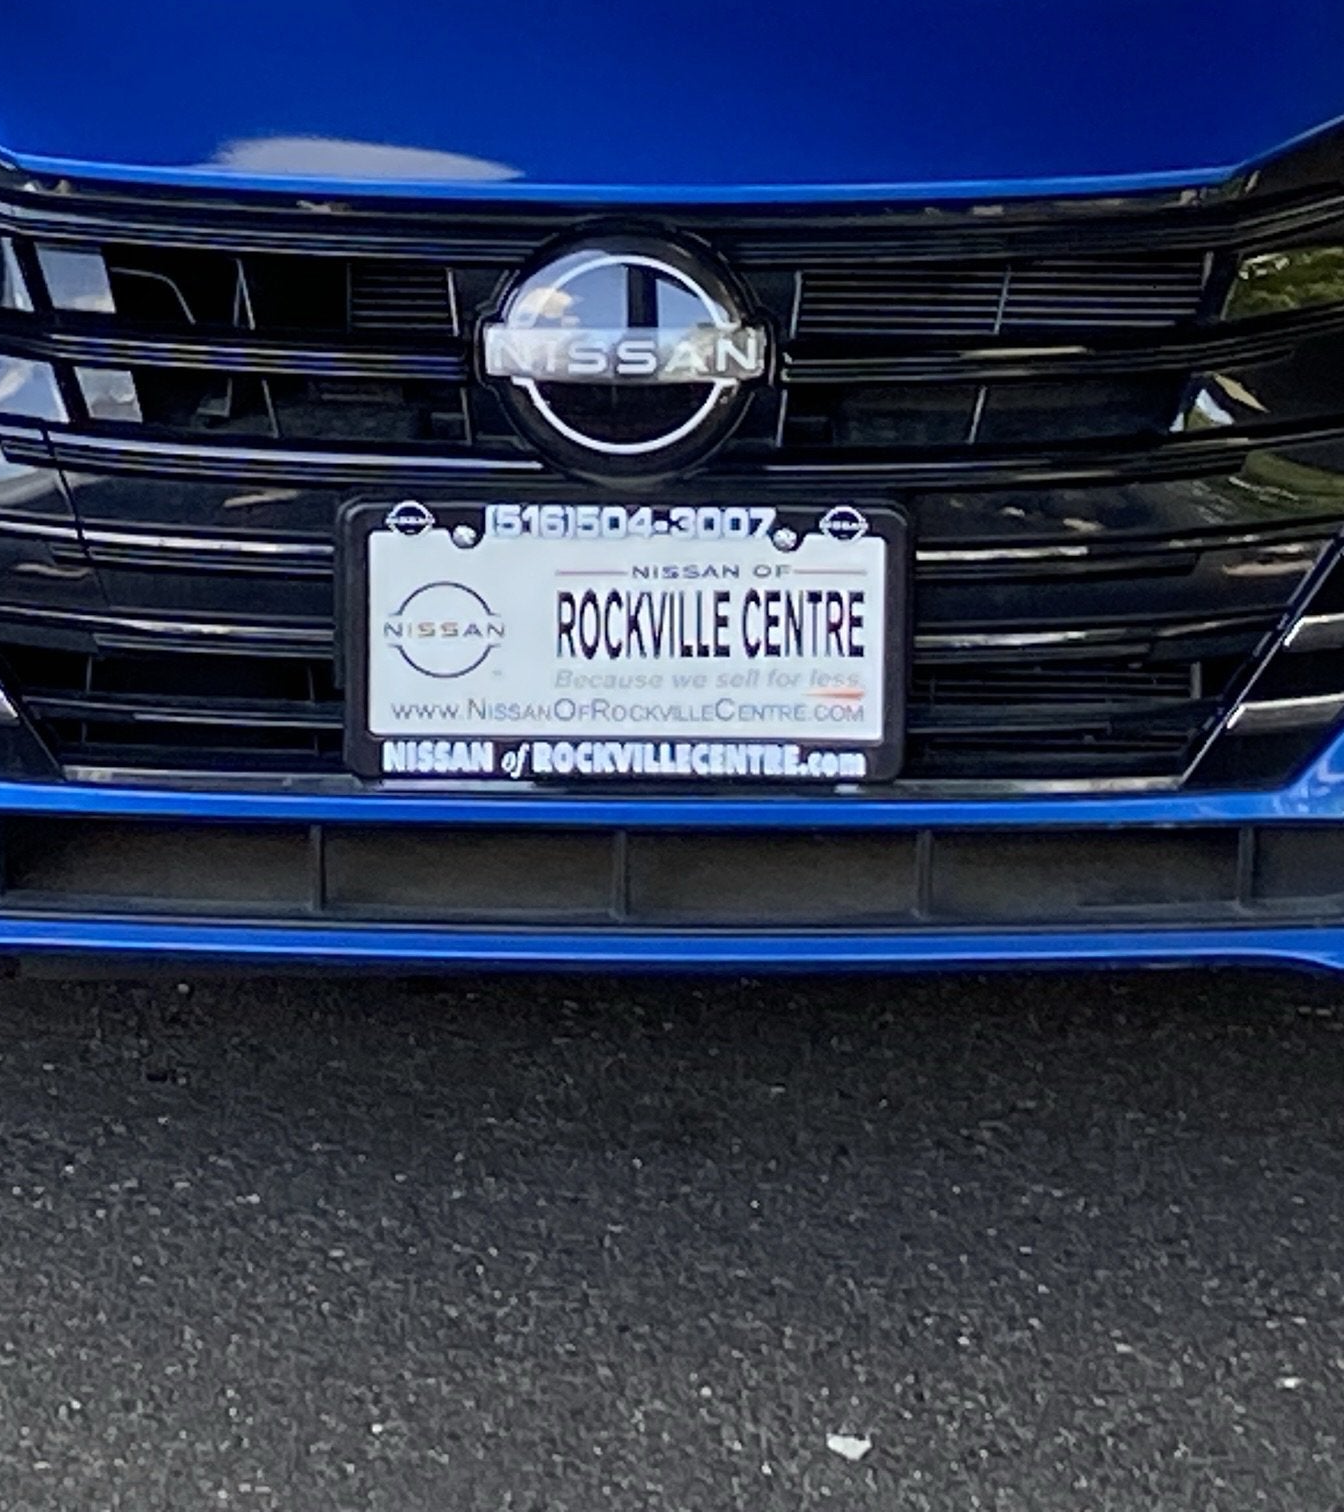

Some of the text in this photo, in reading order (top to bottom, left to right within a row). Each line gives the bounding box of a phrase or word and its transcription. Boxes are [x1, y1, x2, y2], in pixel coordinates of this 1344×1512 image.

[491, 331, 758, 376] NISSAN
[484, 503, 778, 539] (516)504-3007
[631, 564, 793, 579] NISSAN OF
[383, 621, 506, 639] NISSAN
[557, 588, 865, 660] ROCKVILLE CENTRE
[555, 668, 664, 689] Because
[671, 673, 708, 689] we
[767, 667, 802, 689] for
[382, 741, 867, 779] NISSAN of ROCKVILLECENTRE.com
